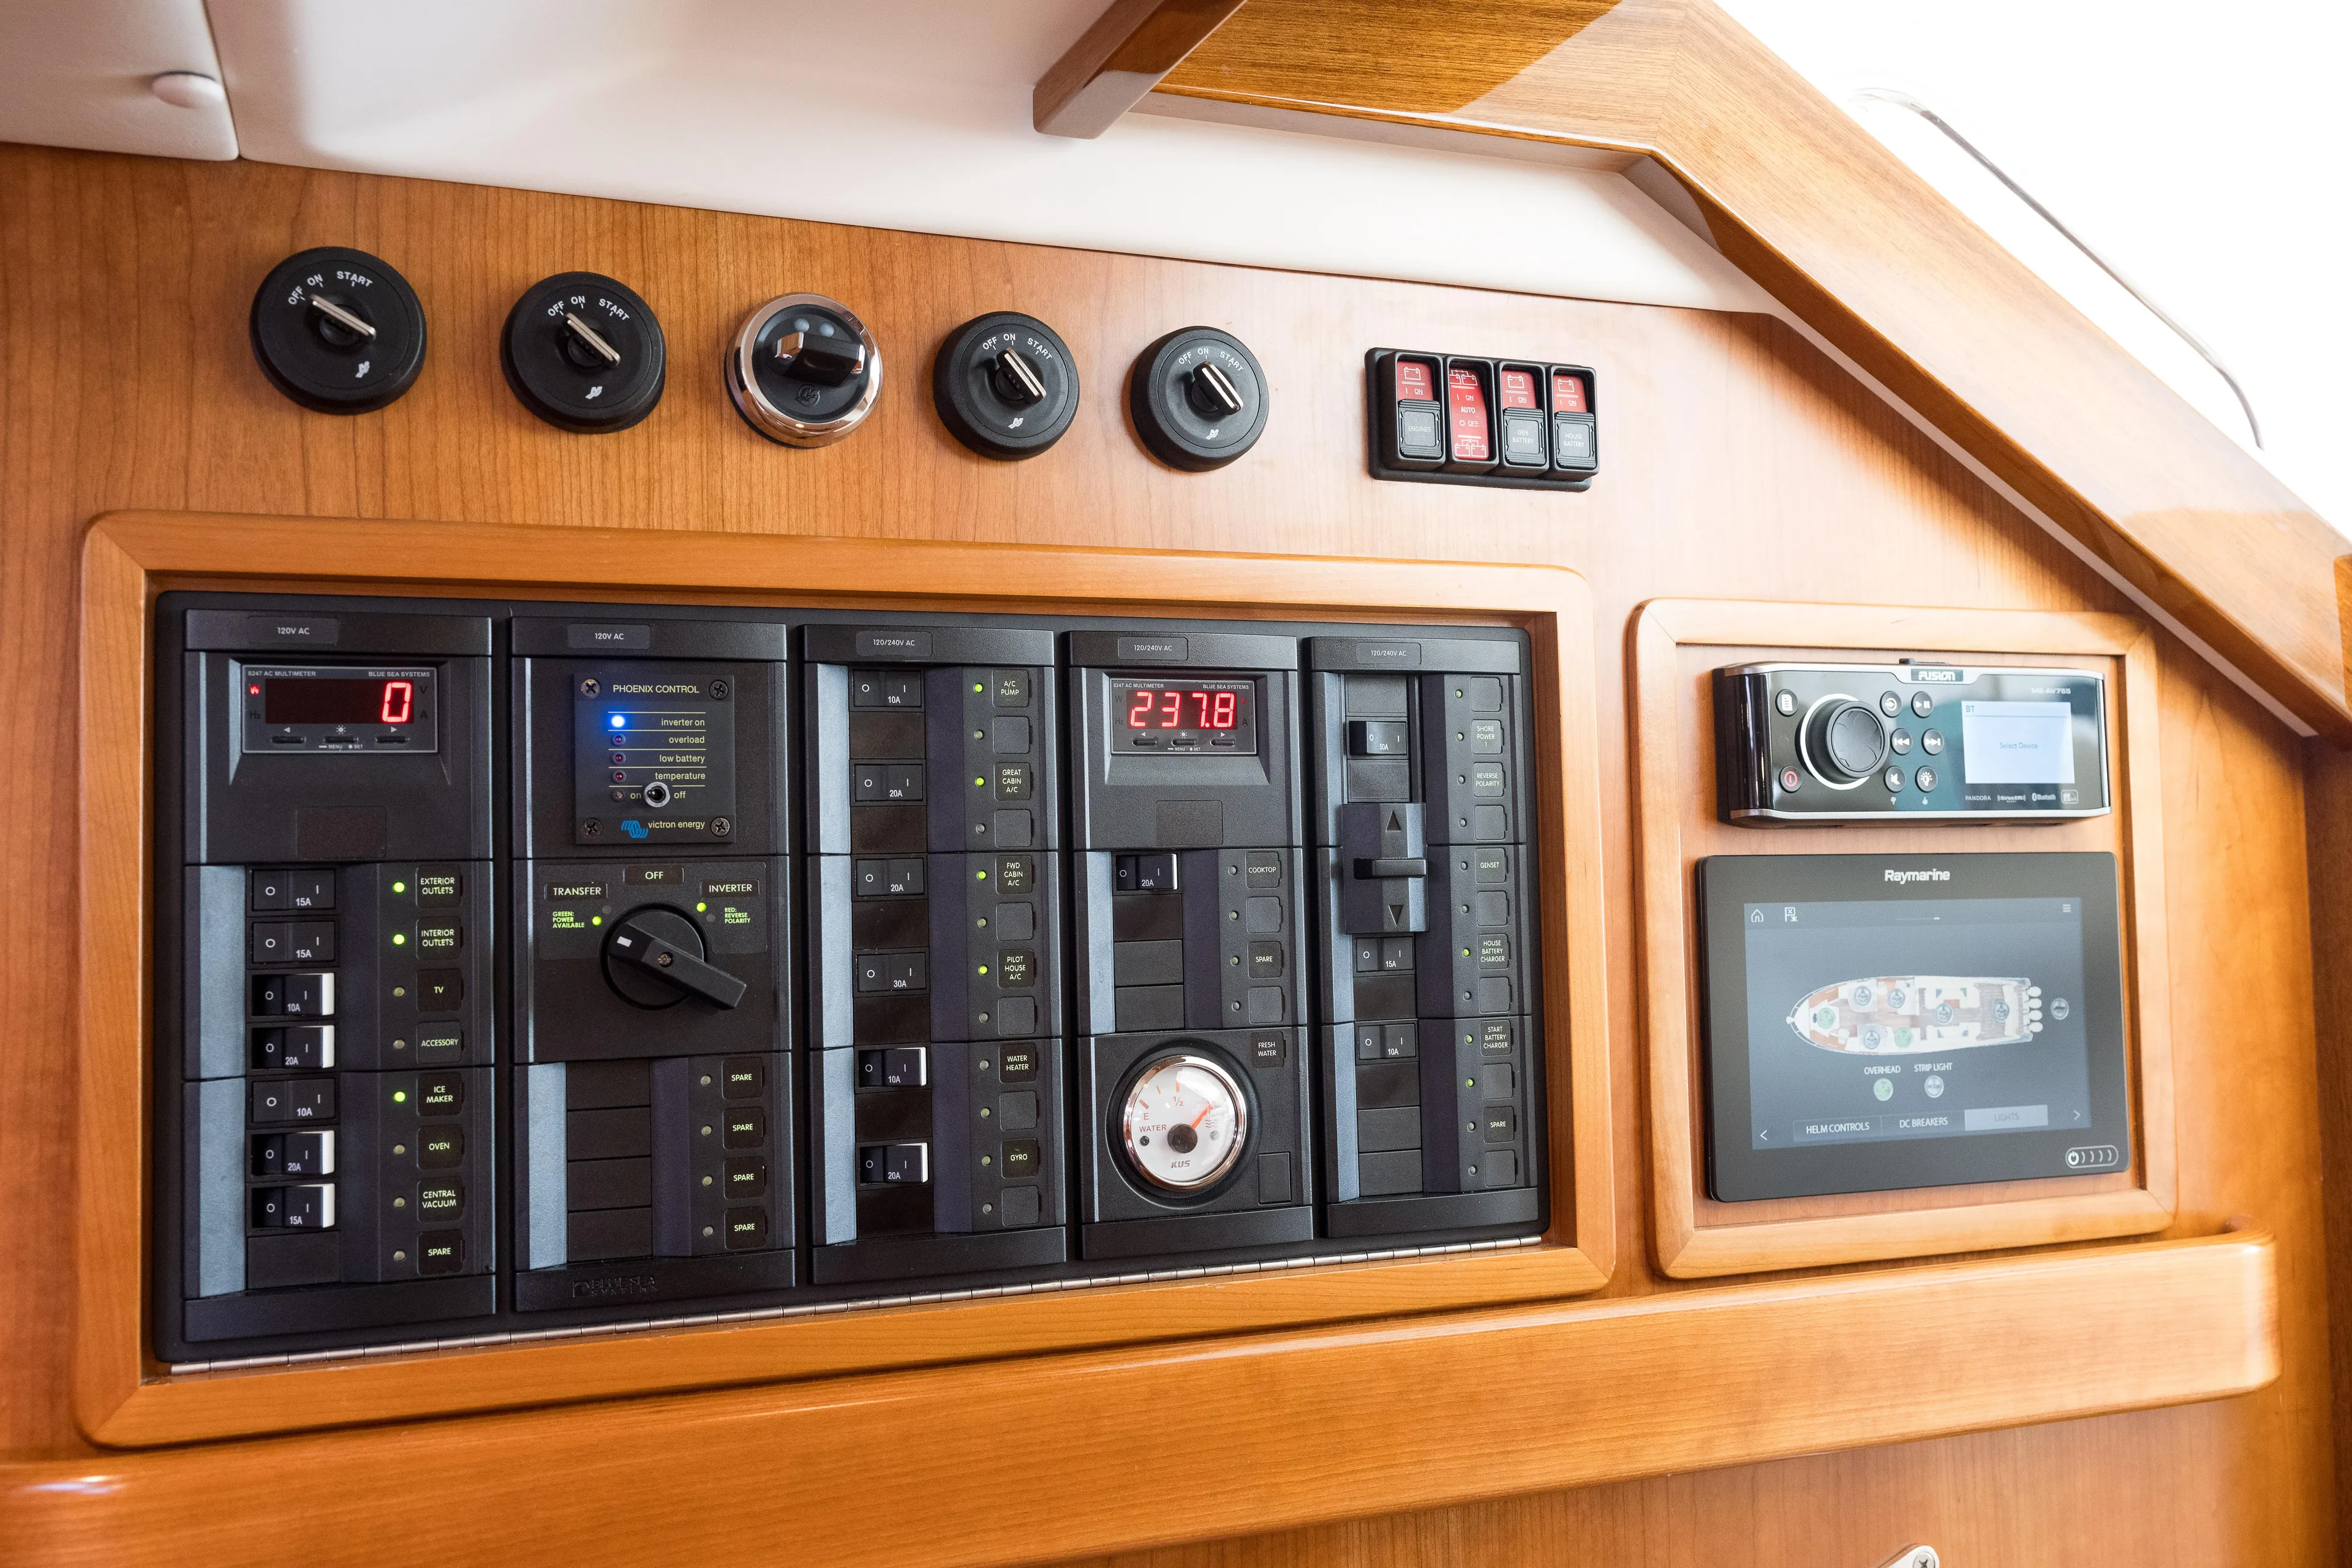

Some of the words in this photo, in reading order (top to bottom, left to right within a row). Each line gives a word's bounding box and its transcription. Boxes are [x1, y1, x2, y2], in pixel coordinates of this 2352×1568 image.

[307, 274, 323, 287] ON
[336, 270, 373, 288] START
[287, 285, 304, 306] OFF
[570, 295, 586, 306] ON
[547, 301, 565, 317] OFF
[598, 298, 630, 322] START
[982, 336, 998, 350] OFF
[1027, 337, 1052, 360] START
[1178, 351, 1192, 365] OFF
[1219, 351, 1244, 372] START
[382, 682, 411, 723] 0
[1130, 692, 1235, 728] 237.8
[676, 755, 705, 764] battery
[655, 772, 706, 781] temperature
[1884, 869, 1950, 884] Raymarine
[553, 887, 601, 895] TRANSFER
[709, 884, 752, 892] INVERTER
[296, 949, 312, 958] 15A
[287, 1003, 300, 1012] 10A
[285, 1057, 298, 1065] 20A
[1864, 1065, 1901, 1074] OVERHEAD
[1933, 1063, 1953, 1071] LIGHT
[296, 1107, 312, 1116] 10A
[1899, 1119, 1910, 1128] DC
[1912, 1117, 1948, 1128] BREAKERS
[1994, 1113, 2019, 1122] LIGHTS
[1139, 1124, 1166, 1133] WATER
[1806, 1124, 1828, 1134] HELM
[1829, 1121, 1870, 1133] CONTROLS
[288, 1163, 301, 1171] 20A
[423, 1190, 456, 1199] CENTRAL
[290, 1216, 303, 1224] 15A
